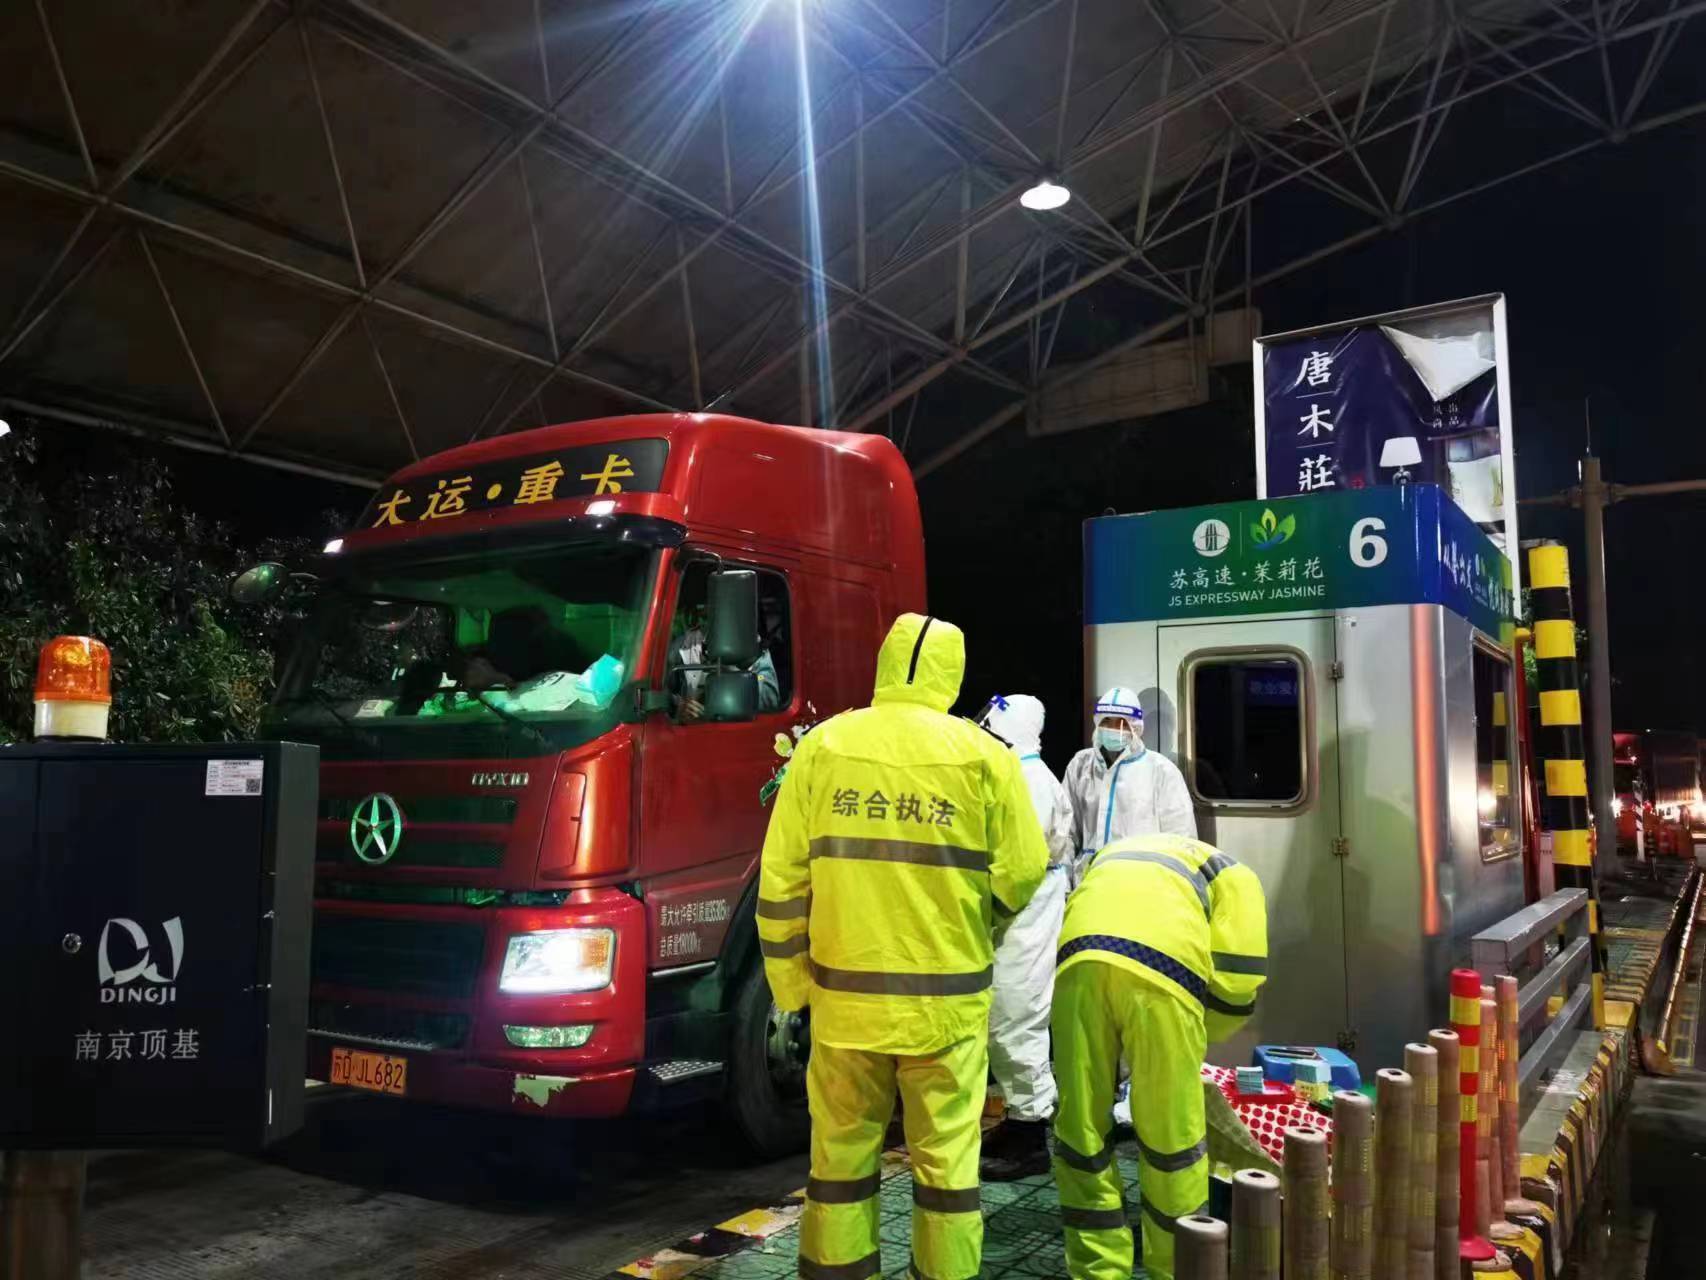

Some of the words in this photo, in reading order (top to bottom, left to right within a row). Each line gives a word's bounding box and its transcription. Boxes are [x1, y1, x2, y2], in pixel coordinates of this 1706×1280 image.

[1295, 351, 1336, 492] 唐木莊
[1349, 516, 1389, 568] 6
[1168, 595, 1183, 607] JS
[1185, 590, 1265, 606] EXPRESSWAY
[1268, 584, 1326, 600] JASMINE
[831, 788, 956, 828] 综合执法
[100, 987, 177, 1005] DINGJI
[74, 1028, 201, 1061] 南京顶基
